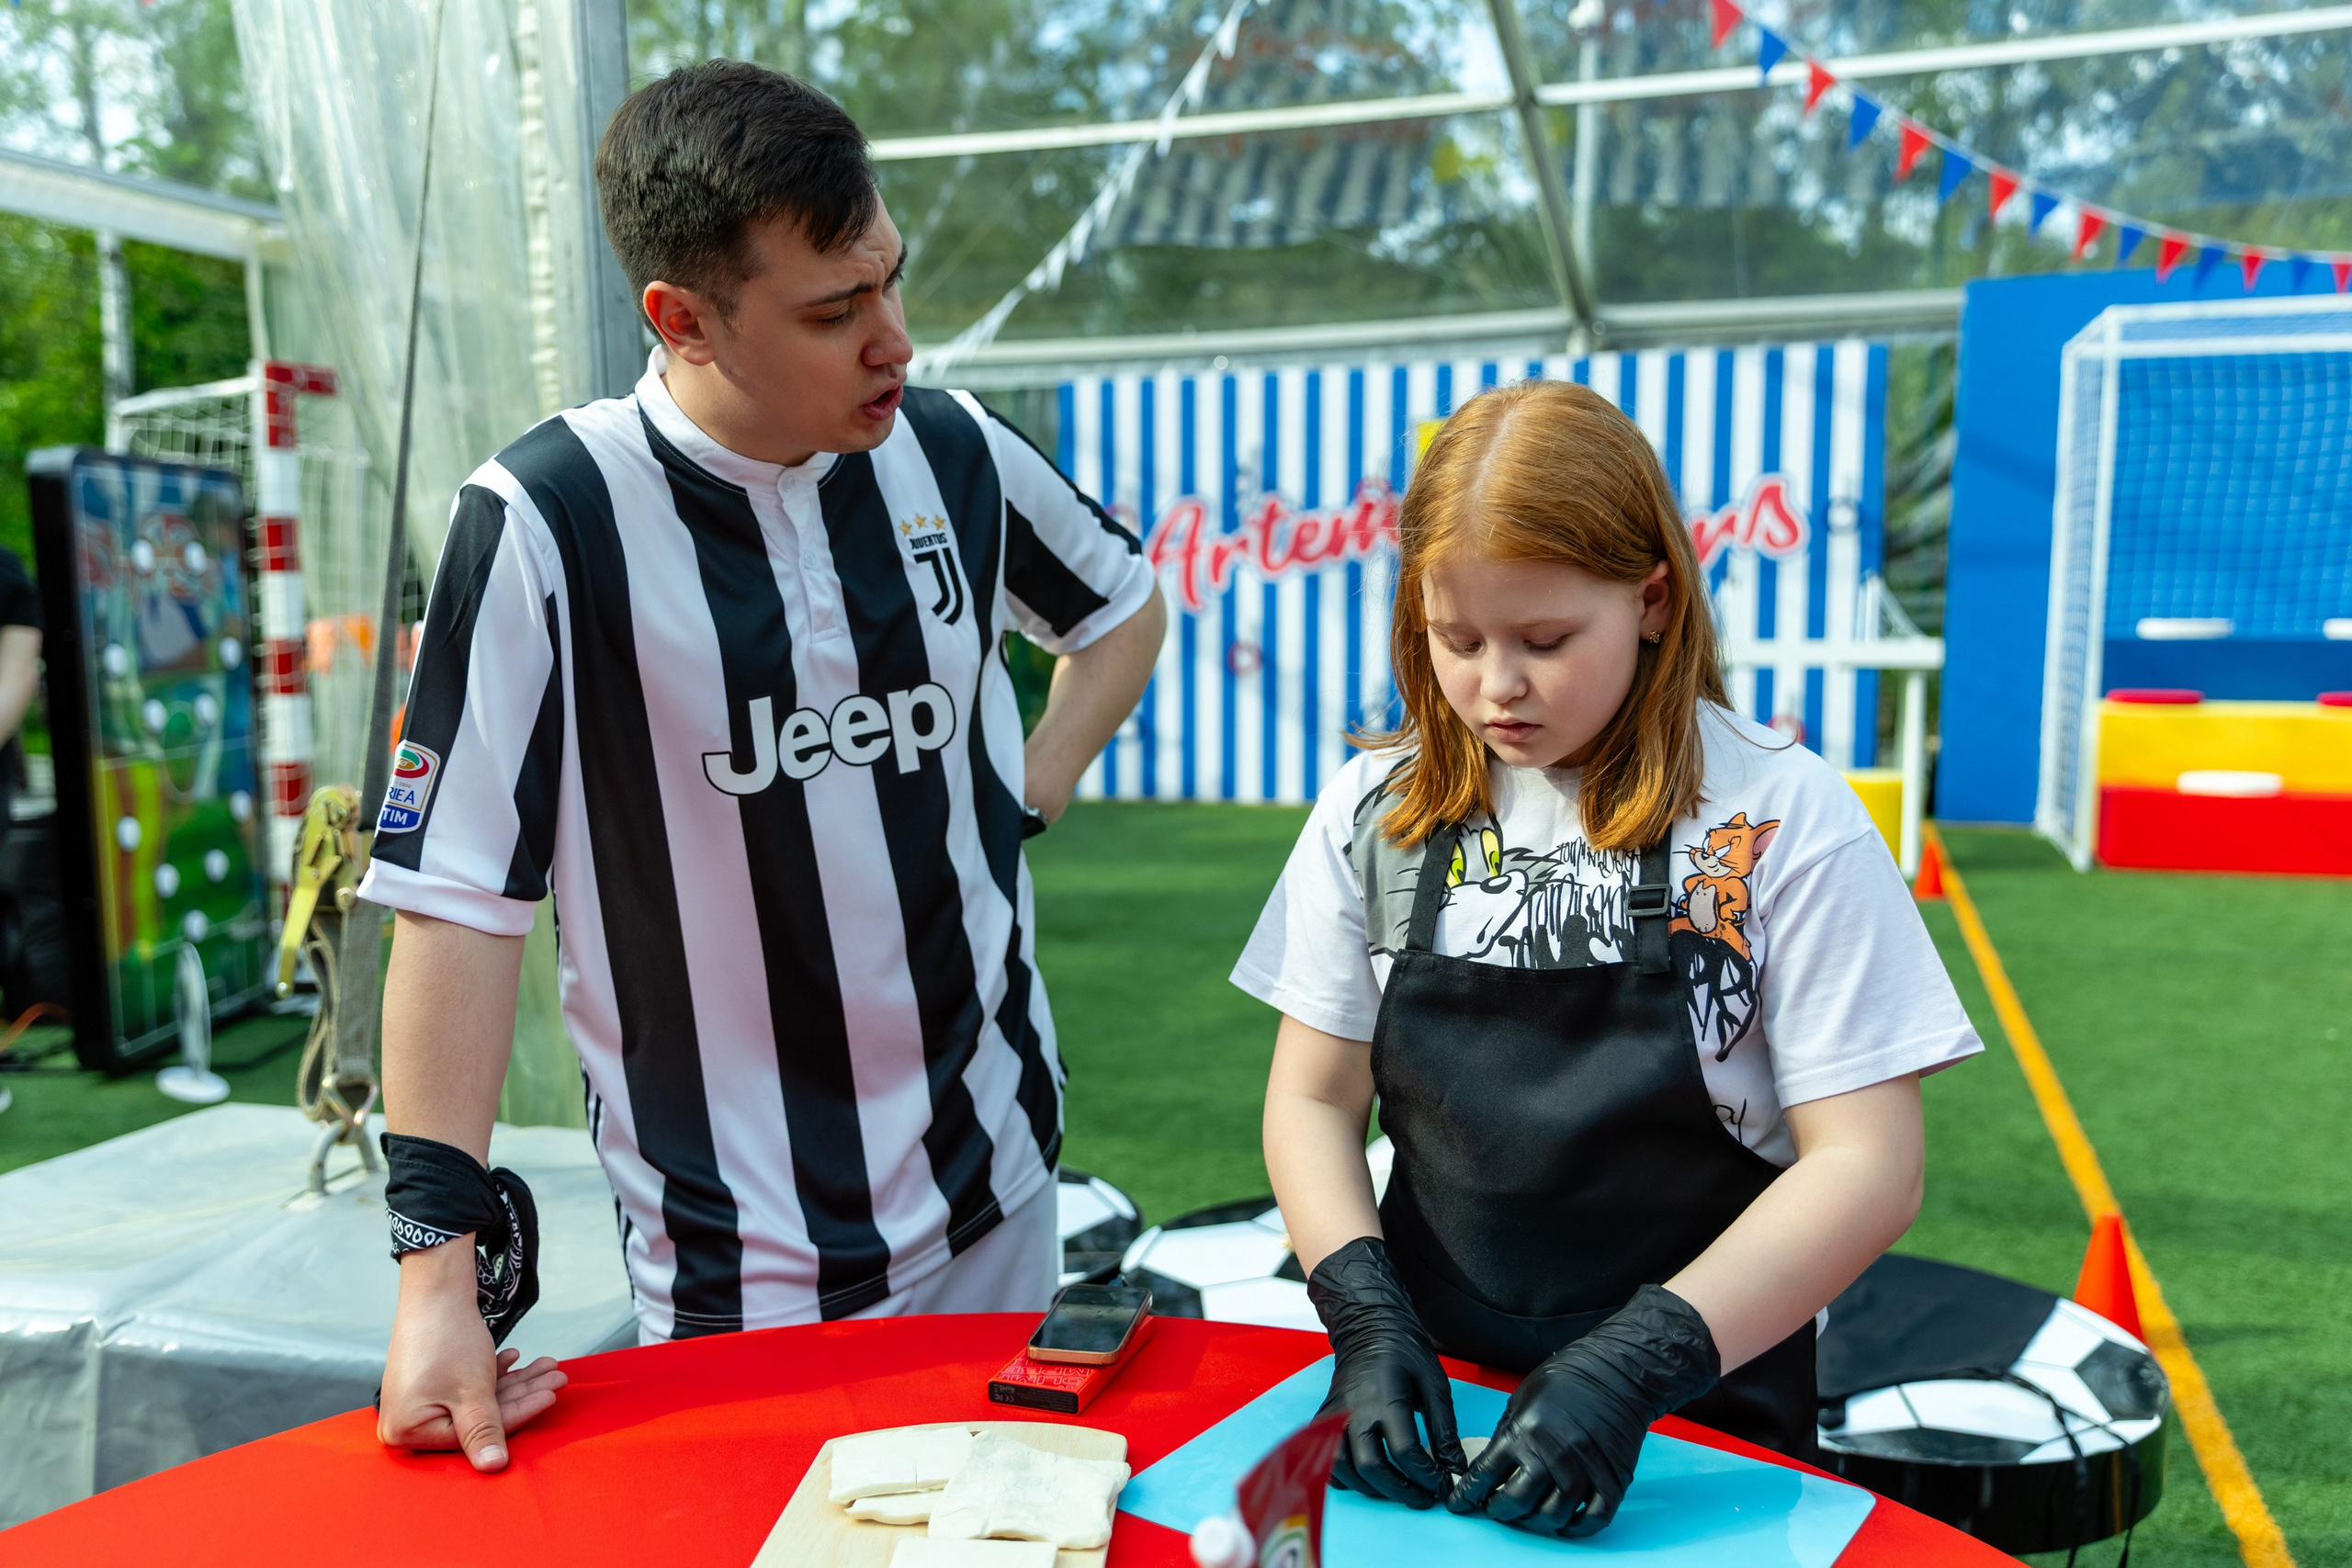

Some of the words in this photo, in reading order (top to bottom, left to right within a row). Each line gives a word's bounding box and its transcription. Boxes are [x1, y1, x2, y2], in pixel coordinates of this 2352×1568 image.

[910, 533, 947, 549] JUVENTUS
[702, 682, 956, 795] Jeep
[389, 786, 404, 801] RIE
[404, 790, 414, 805] A
[382, 807, 408, 825] TIM
